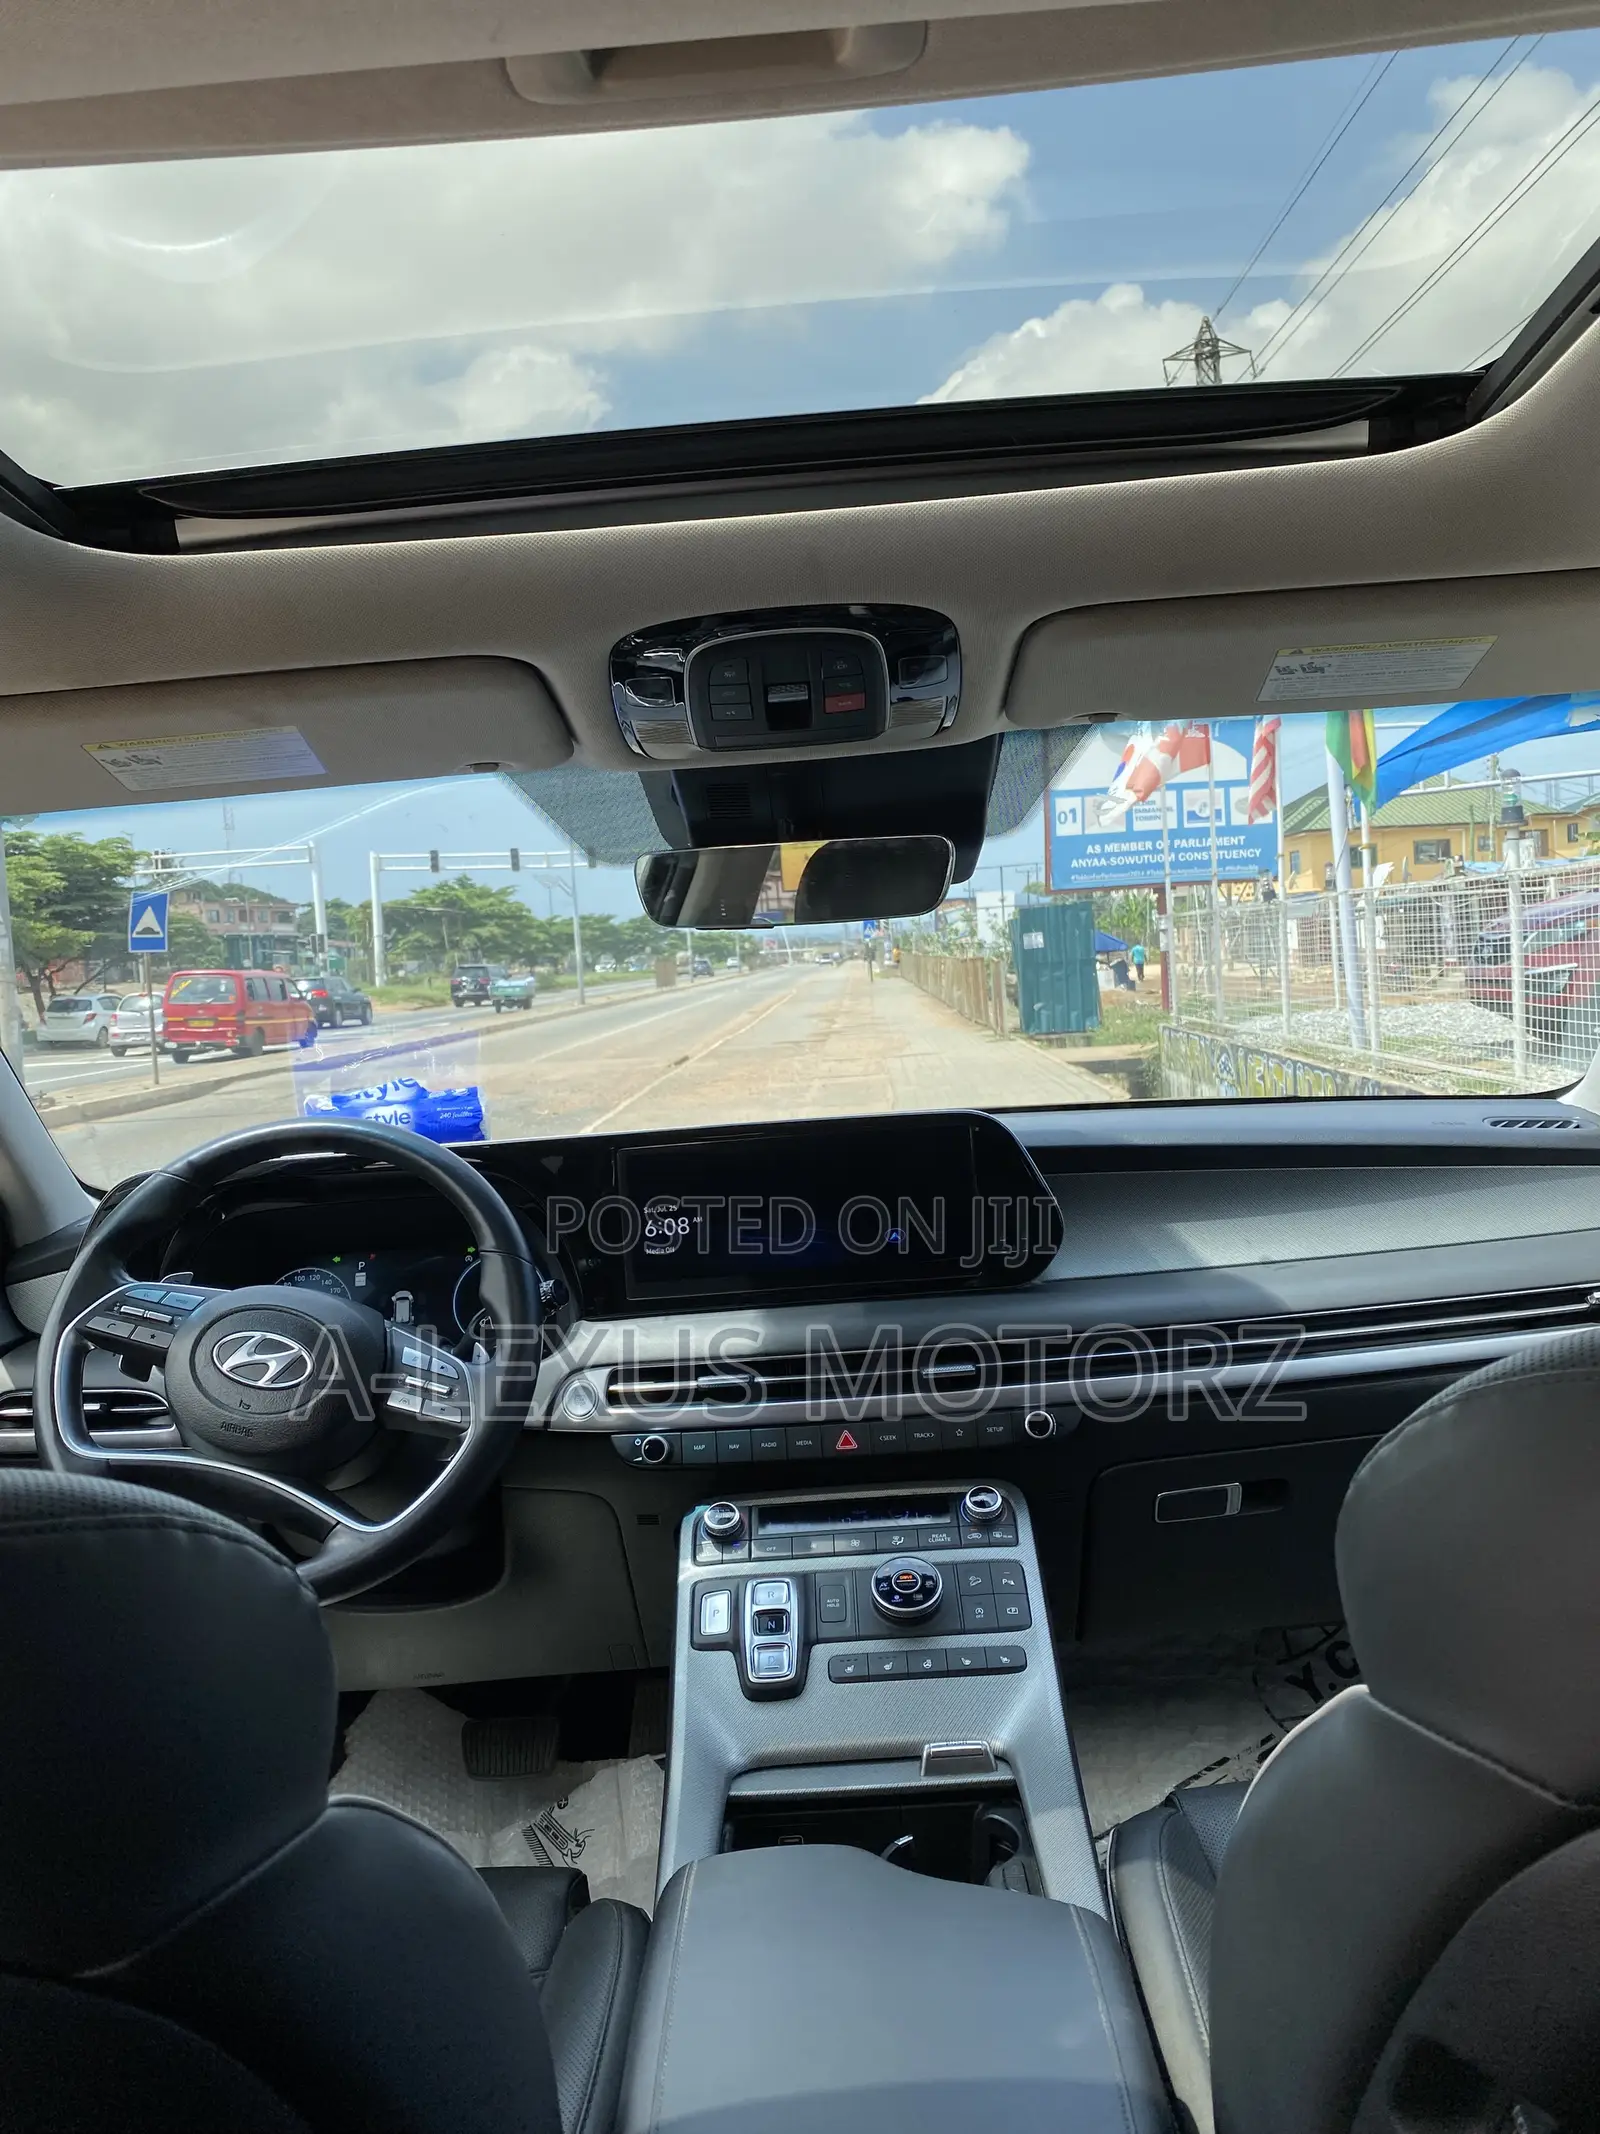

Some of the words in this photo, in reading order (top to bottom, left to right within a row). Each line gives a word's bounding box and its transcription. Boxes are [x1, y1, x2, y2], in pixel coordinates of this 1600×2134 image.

[1057, 807, 1078, 825] 01
[1086, 844, 1101, 855] AS
[1104, 841, 1153, 853] MEMBER
[644, 1216, 690, 1238] 6:08
[358, 1261, 366, 1271] P
[767, 1590, 775, 1599] R
[712, 1609, 720, 1618] P
[767, 1620, 776, 1630] N
